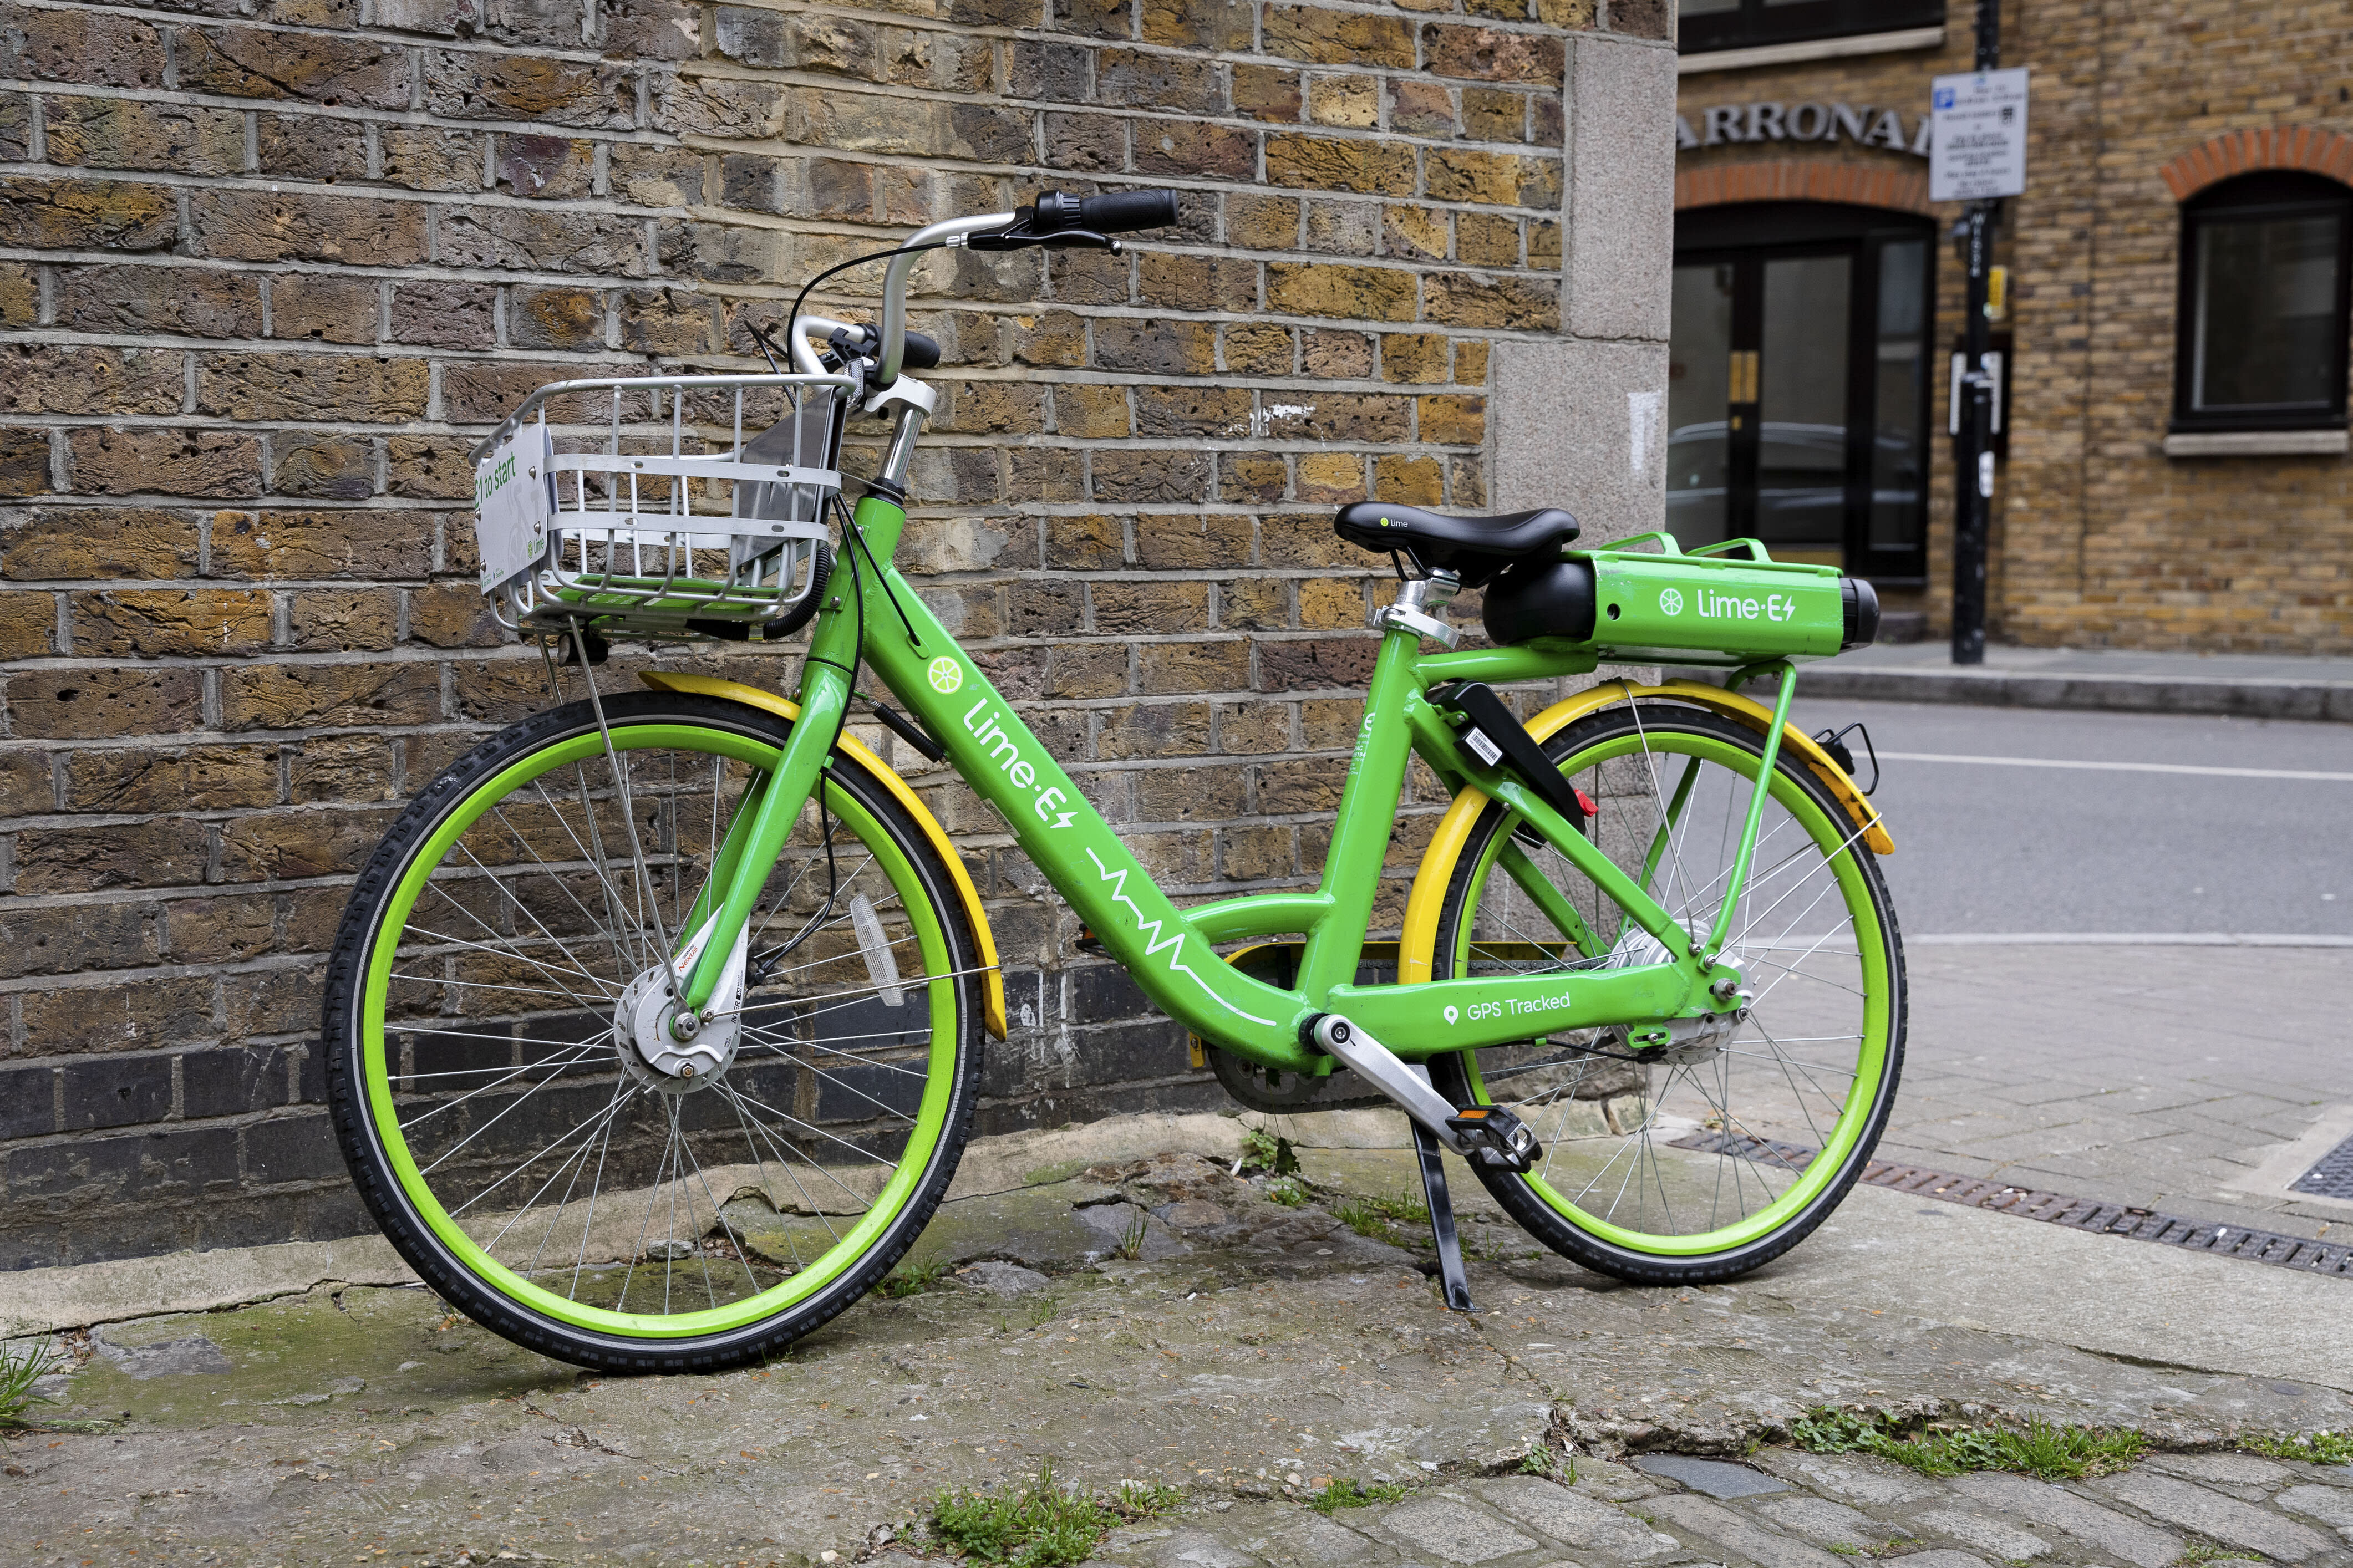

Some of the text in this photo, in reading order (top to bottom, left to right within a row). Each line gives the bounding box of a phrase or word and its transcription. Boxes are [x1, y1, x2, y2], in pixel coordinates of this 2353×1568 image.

[475, 451, 516, 510] £1 to start
[1390, 519, 1408, 528] Lime
[533, 538, 545, 554] Lime
[1467, 991, 1571, 1020] GPS Tracked
